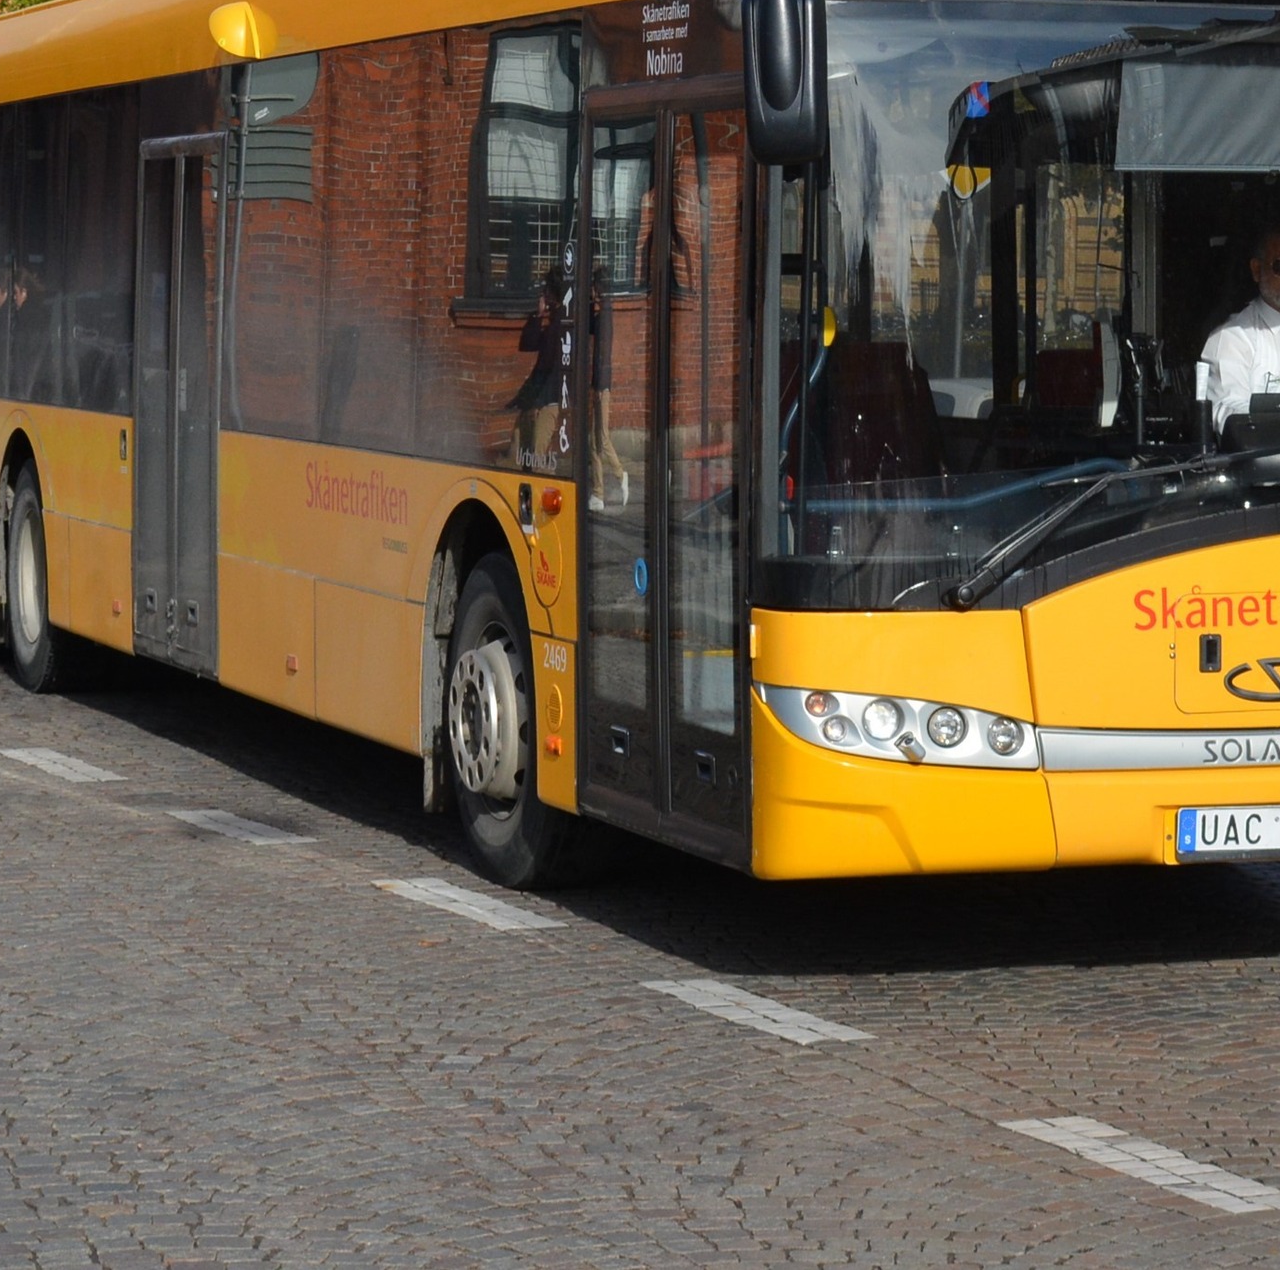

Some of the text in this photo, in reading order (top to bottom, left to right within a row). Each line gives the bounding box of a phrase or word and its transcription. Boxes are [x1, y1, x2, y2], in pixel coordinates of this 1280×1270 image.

[642, 1, 690, 24] Skånetrafiken
[646, 25, 675, 42] samarbete
[675, 22, 688, 39] med
[646, 46, 683, 77] Nobina
[305, 460, 408, 525] Skånetrafiken
[543, 642, 567, 673] 2469
[1184, 834, 1192, 845] S
[1200, 814, 1263, 846] UAC
